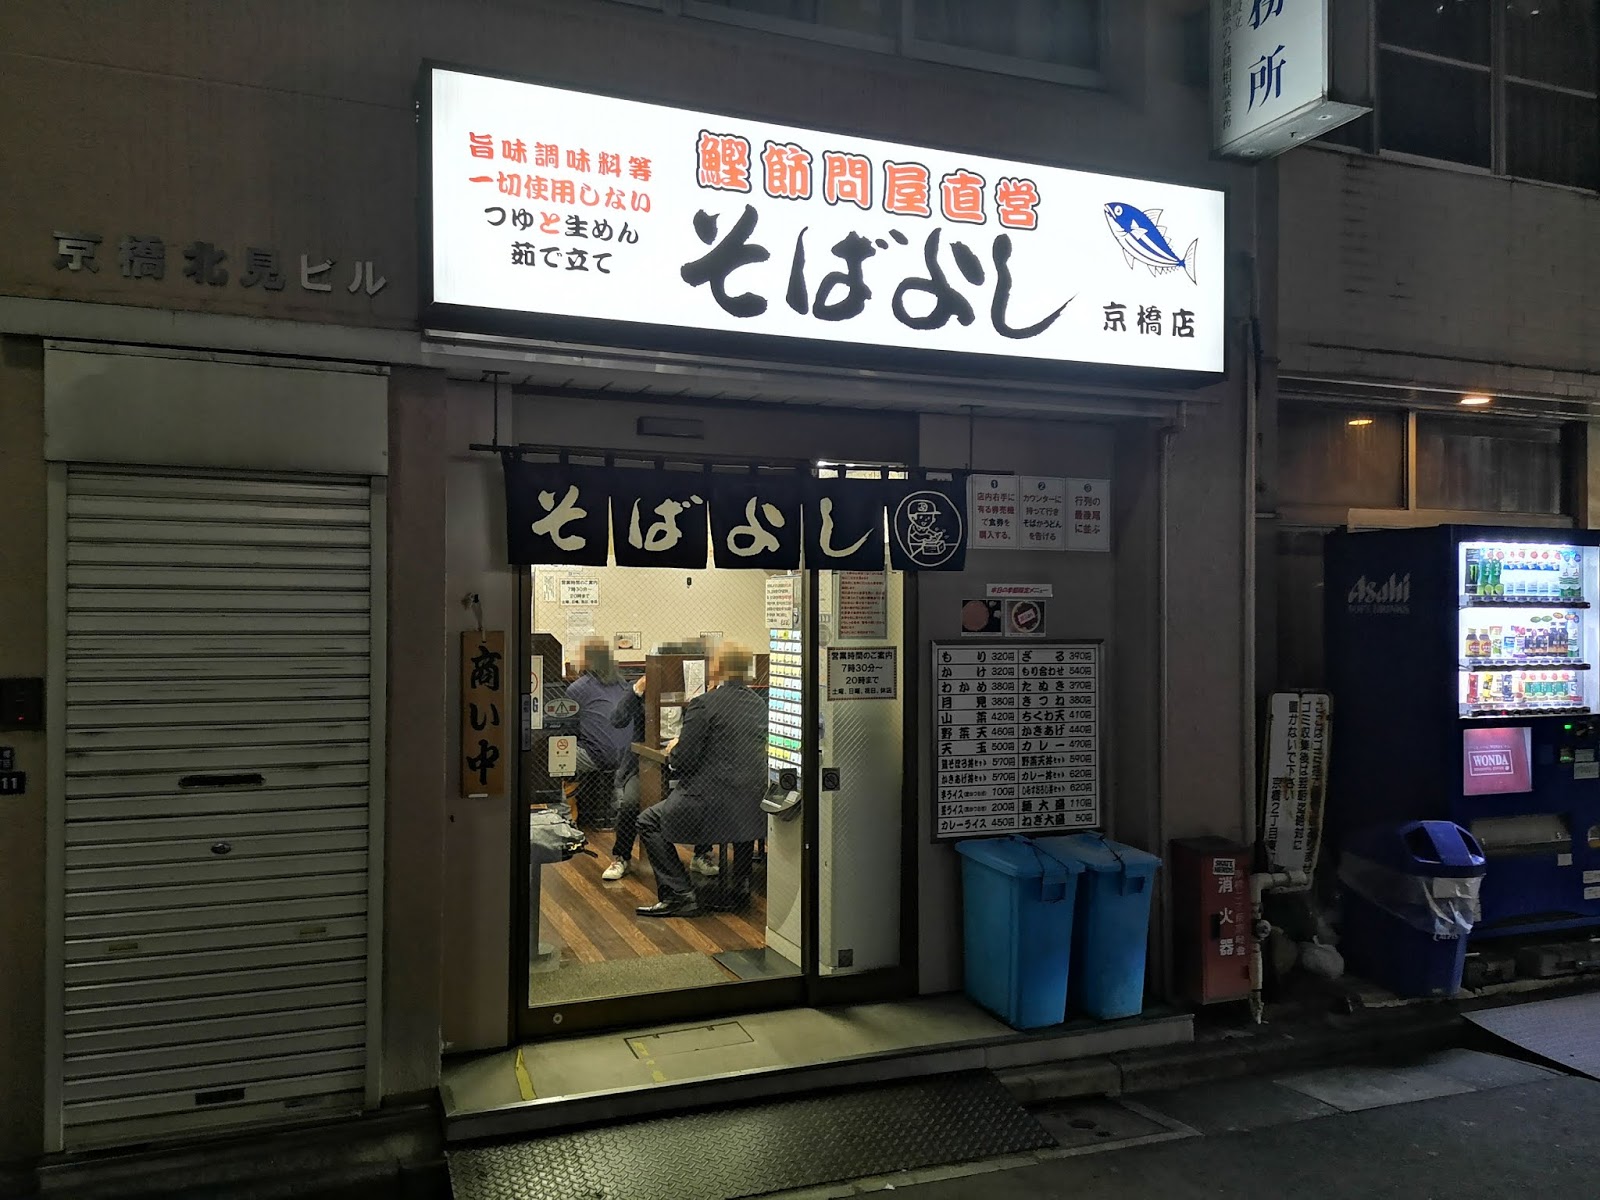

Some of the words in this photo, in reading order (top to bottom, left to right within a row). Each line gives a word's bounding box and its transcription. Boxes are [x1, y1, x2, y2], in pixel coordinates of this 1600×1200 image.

[469, 132, 652, 181] 旨味調味料等
[696, 129, 1041, 230] 鰹節問屋直営
[469, 171, 651, 213] 一切使用しない
[484, 207, 639, 244] つゆと生めん
[511, 241, 612, 274] 茹で立て
[53, 230, 387, 297] 京橋北見ビル
[680, 204, 1079, 339] そばよし
[1103, 301, 1194, 337] 京橋店
[977, 492, 1015, 501] 店内右手に
[1023, 495, 1062, 504] カウンターに
[1075, 496, 1100, 506] 行列の
[977, 505, 1015, 515] 有る券売機
[1026, 507, 1059, 516] 持って行き
[1075, 510, 1100, 520] 最後尾
[532, 485, 875, 558] そばよし
[981, 518, 1010, 527] で食券を
[1023, 519, 1062, 528] そばかうどん
[1075, 524, 1100, 534] に並ぶ
[1029, 532, 1056, 541] を告げる
[1347, 572, 1410, 604] Asahi
[831, 651, 893, 660] 営業時間のご案内
[991, 652, 1014, 661] 320円
[942, 667, 986, 677] かけ
[991, 667, 1014, 676] 320円
[1022, 666, 1064, 676] もり合わせ
[1069, 667, 1091, 675] 540円
[942, 682, 986, 692] わかめ
[1022, 681, 1064, 691] たぬき
[942, 696, 986, 708] 月見
[1022, 695, 1064, 706] きつね
[466, 645, 502, 786] 商い中
[991, 712, 1014, 720] 420円
[1022, 710, 1064, 721] ちくわ天
[1069, 711, 1091, 719] 410円
[941, 727, 986, 739] 野菜天
[1022, 724, 1065, 736] かきあげ
[1069, 725, 1091, 733] 440円
[992, 742, 1014, 750] 500円
[1022, 740, 1064, 751] カレー
[993, 757, 1015, 766] 570円
[1473, 754, 1509, 767] WONDA
[993, 773, 1015, 781] 570円
[993, 788, 1014, 796] 100円
[1070, 783, 1092, 791] 620円
[992, 803, 1014, 811] 200円
[1076, 813, 1092, 822] 50円
[942, 819, 986, 830] カレーライス
[992, 818, 1014, 826] 450円
[1218, 876, 1234, 956] 消火器
